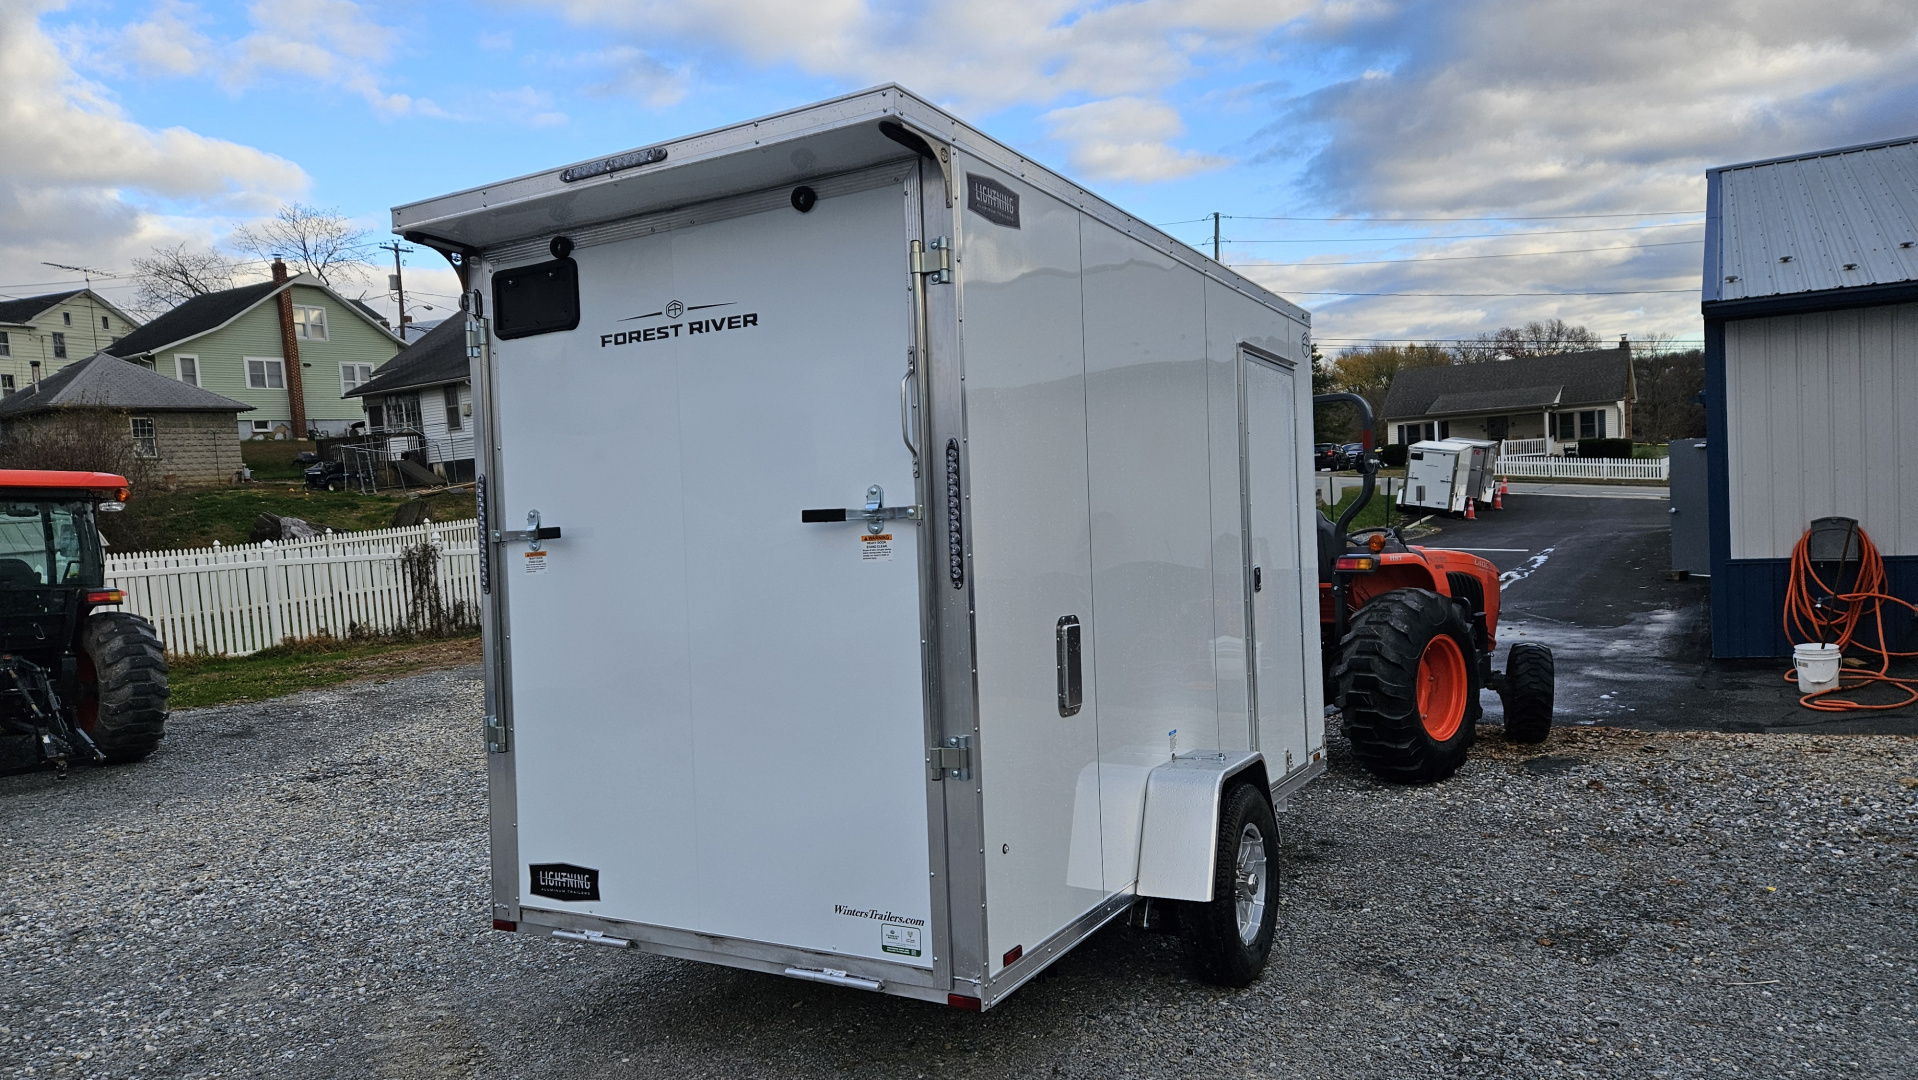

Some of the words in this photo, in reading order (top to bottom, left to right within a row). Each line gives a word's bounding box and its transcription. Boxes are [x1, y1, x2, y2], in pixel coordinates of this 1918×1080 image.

[975, 182, 1014, 214] LIGHTNING
[600, 323, 683, 348] FOREST
[688, 312, 758, 335] RIVER
[540, 870, 591, 889] LIGHTNING
[834, 904, 925, 926] WintersTrailers.com
